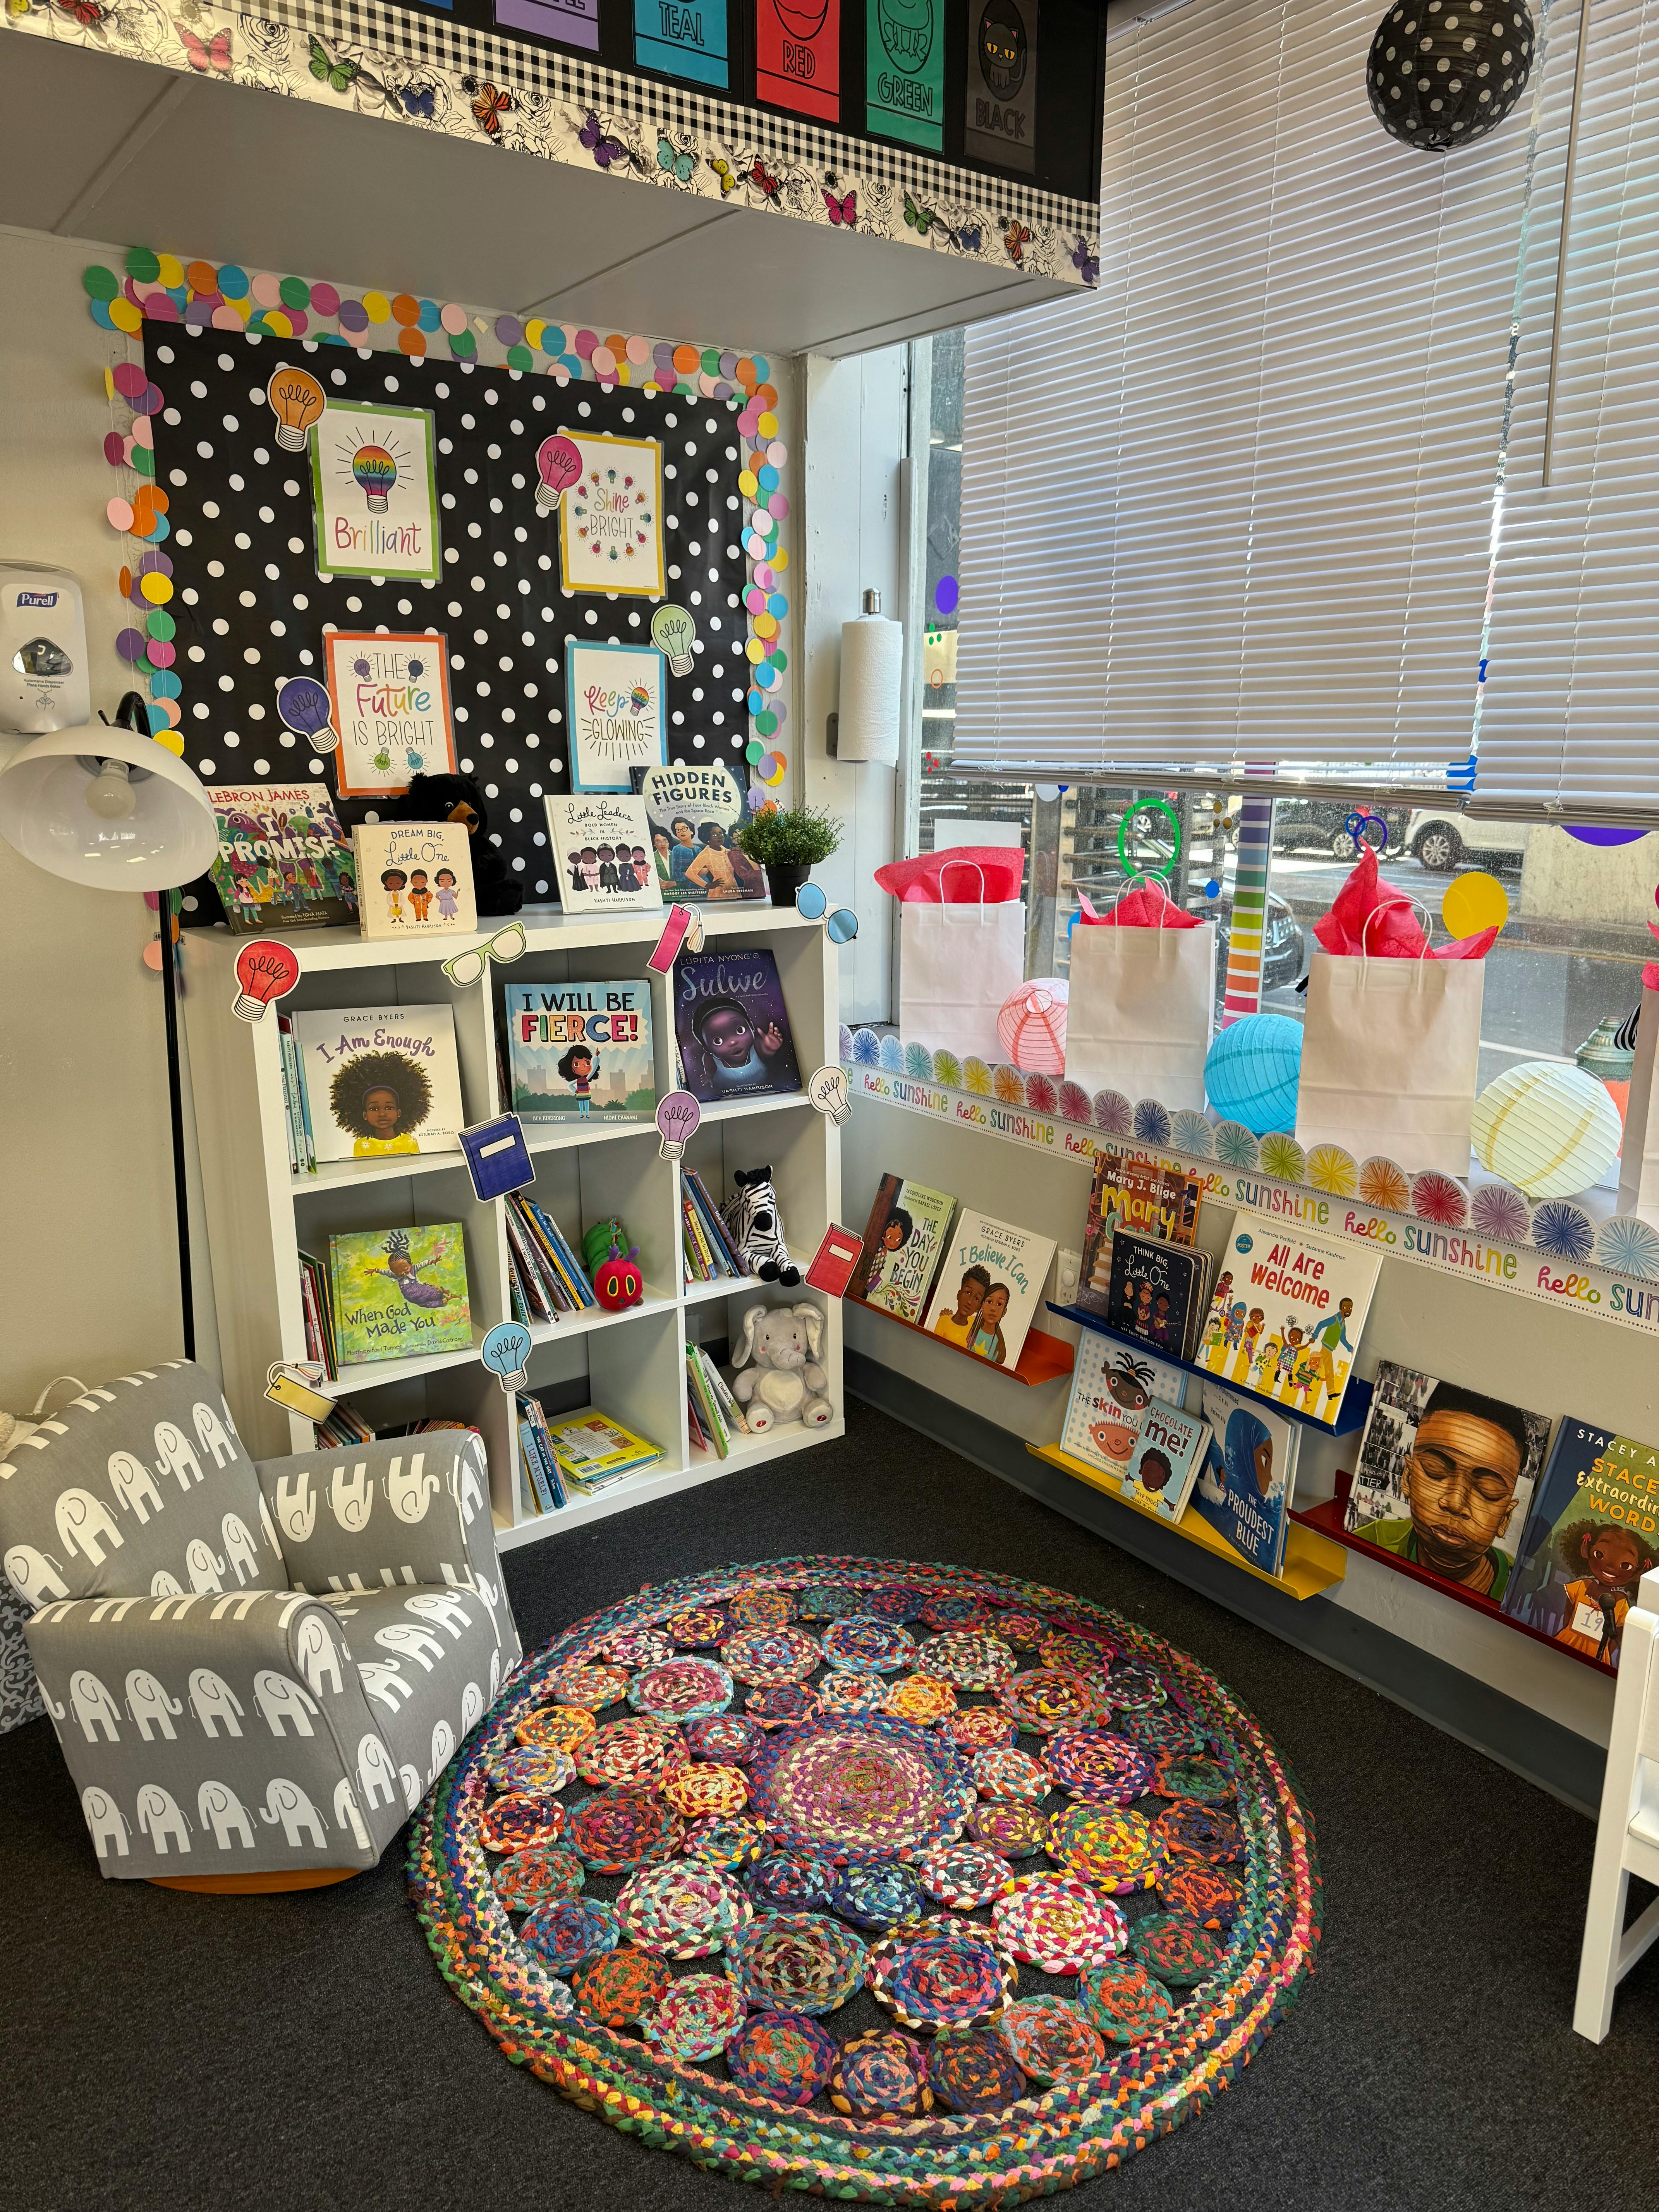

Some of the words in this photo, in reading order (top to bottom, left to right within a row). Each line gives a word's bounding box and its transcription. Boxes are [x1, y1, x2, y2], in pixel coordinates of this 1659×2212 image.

[659, 2, 704, 46] TEAL
[783, 40, 815, 79] RED
[878, 72, 933, 116] GREEN
[976, 98, 1025, 138] BLACK
[594, 488, 629, 513] Shine
[335, 517, 421, 554] Brilliant
[590, 514, 633, 539] BRIGHT
[22, 594, 53, 605] Purell
[373, 653, 404, 679] THE
[357, 684, 431, 717] Future
[584, 685, 627, 717] Keep
[353, 721, 368, 745] IS
[376, 720, 434, 745] BRIGHT
[592, 720, 643, 741] GLOWING
[651, 772, 725, 789] HIDDEN
[268, 789, 309, 802] JAMES
[652, 787, 733, 805] FIGURES
[565, 802, 596, 824] Little
[594, 800, 634, 821] Leaders
[260, 817, 279, 837] I
[391, 830, 423, 840] DREAM
[426, 830, 444, 841] BIG,
[219, 836, 340, 862] PROMISE
[384, 842, 420, 867] Little
[421, 842, 449, 862] One
[680, 956, 715, 965] LUPITA
[681, 965, 766, 1001] Sulwe
[522, 993, 532, 1012] I
[536, 993, 599, 1012] WILL
[606, 993, 634, 1012] BE
[521, 1014, 639, 1043] FIERCE!
[316, 1043, 335, 1063] I
[334, 1034, 369, 1055] Am
[374, 1028, 435, 1057] Enough
[1107, 1171, 1133, 1189] Mary
[1137, 1180, 1146, 1191] J.
[1150, 1183, 1176, 1199] Blige
[1115, 1168, 1139, 1178] Award-Winning
[864, 1073, 890, 1095] hello
[893, 1080, 948, 1112] sunshine
[957, 1101, 986, 1124] hello
[990, 1109, 1054, 1144] sunshine
[1065, 1133, 1098, 1158] hello
[1235, 1179, 1329, 1225] sunshine
[1345, 1211, 1396, 1245] hello
[1403, 1225, 1517, 1279] sunshine
[1537, 1266, 1601, 1304] hello
[906, 1189, 926, 1199] JACQUELINE
[927, 1196, 943, 1205] WOODSON
[922, 1218, 938, 1233] THE
[1101, 1184, 1175, 1242] Mary
[910, 1229, 934, 1253] DAY
[981, 1226, 1003, 1239] GRACE
[1005, 1235, 1024, 1247] BYERS
[1258, 1228, 1279, 1239] Alexandra
[1279, 1234, 1296, 1245] Penfold
[1306, 1244, 1325, 1253] Suzanne
[1326, 1249, 1346, 1261] Kaufman
[905, 1247, 929, 1272] YOU
[960, 1247, 967, 1266] I
[969, 1244, 1006, 1269] Believe
[1005, 1255, 1017, 1271] I
[1133, 1246, 1155, 1260] THINK
[1156, 1255, 1168, 1269] BIG,
[1267, 1243, 1290, 1269] All
[1292, 1252, 1325, 1280] Are
[890, 1262, 924, 1293] BEGIN
[1010, 1264, 1029, 1294] Can
[1125, 1254, 1148, 1279] Little
[1149, 1266, 1170, 1291] One
[1250, 1262, 1330, 1309] Welcome
[344, 1307, 383, 1326] When
[385, 1302, 412, 1319] God
[366, 1322, 406, 1339] Made
[411, 1316, 436, 1331] You
[1140, 1335, 1155, 1345] HARRISON
[1219, 1385, 1238, 1405] Muhammad
[1077, 1392, 1091, 1405] THE
[1092, 1396, 1121, 1420] skin
[1121, 1413, 1139, 1429] YOU
[1150, 1406, 1194, 1439] CHOCOLATE
[544, 1427, 554, 1451] GOODNIGHT
[1144, 1420, 1189, 1458] me!
[1577, 1429, 1637, 1458] STACEY
[1088, 1453, 1101, 1463] CHICAGO
[529, 1449, 537, 1465] LIKE
[534, 1466, 547, 1496] MYSELF!
[1592, 1458, 1659, 1495] STACE
[1135, 1490, 1145, 1498] TAYE
[1146, 1496, 1158, 1507] DIGGS
[1248, 1493, 1257, 1507] THE
[1577, 1471, 1659, 1518] Extraordin
[1228, 1489, 1274, 1544] PROUDEST
[1590, 1494, 1659, 1536] WORD
[1236, 1520, 1260, 1556] BLUE
[1580, 1613, 1604, 1632] 19
